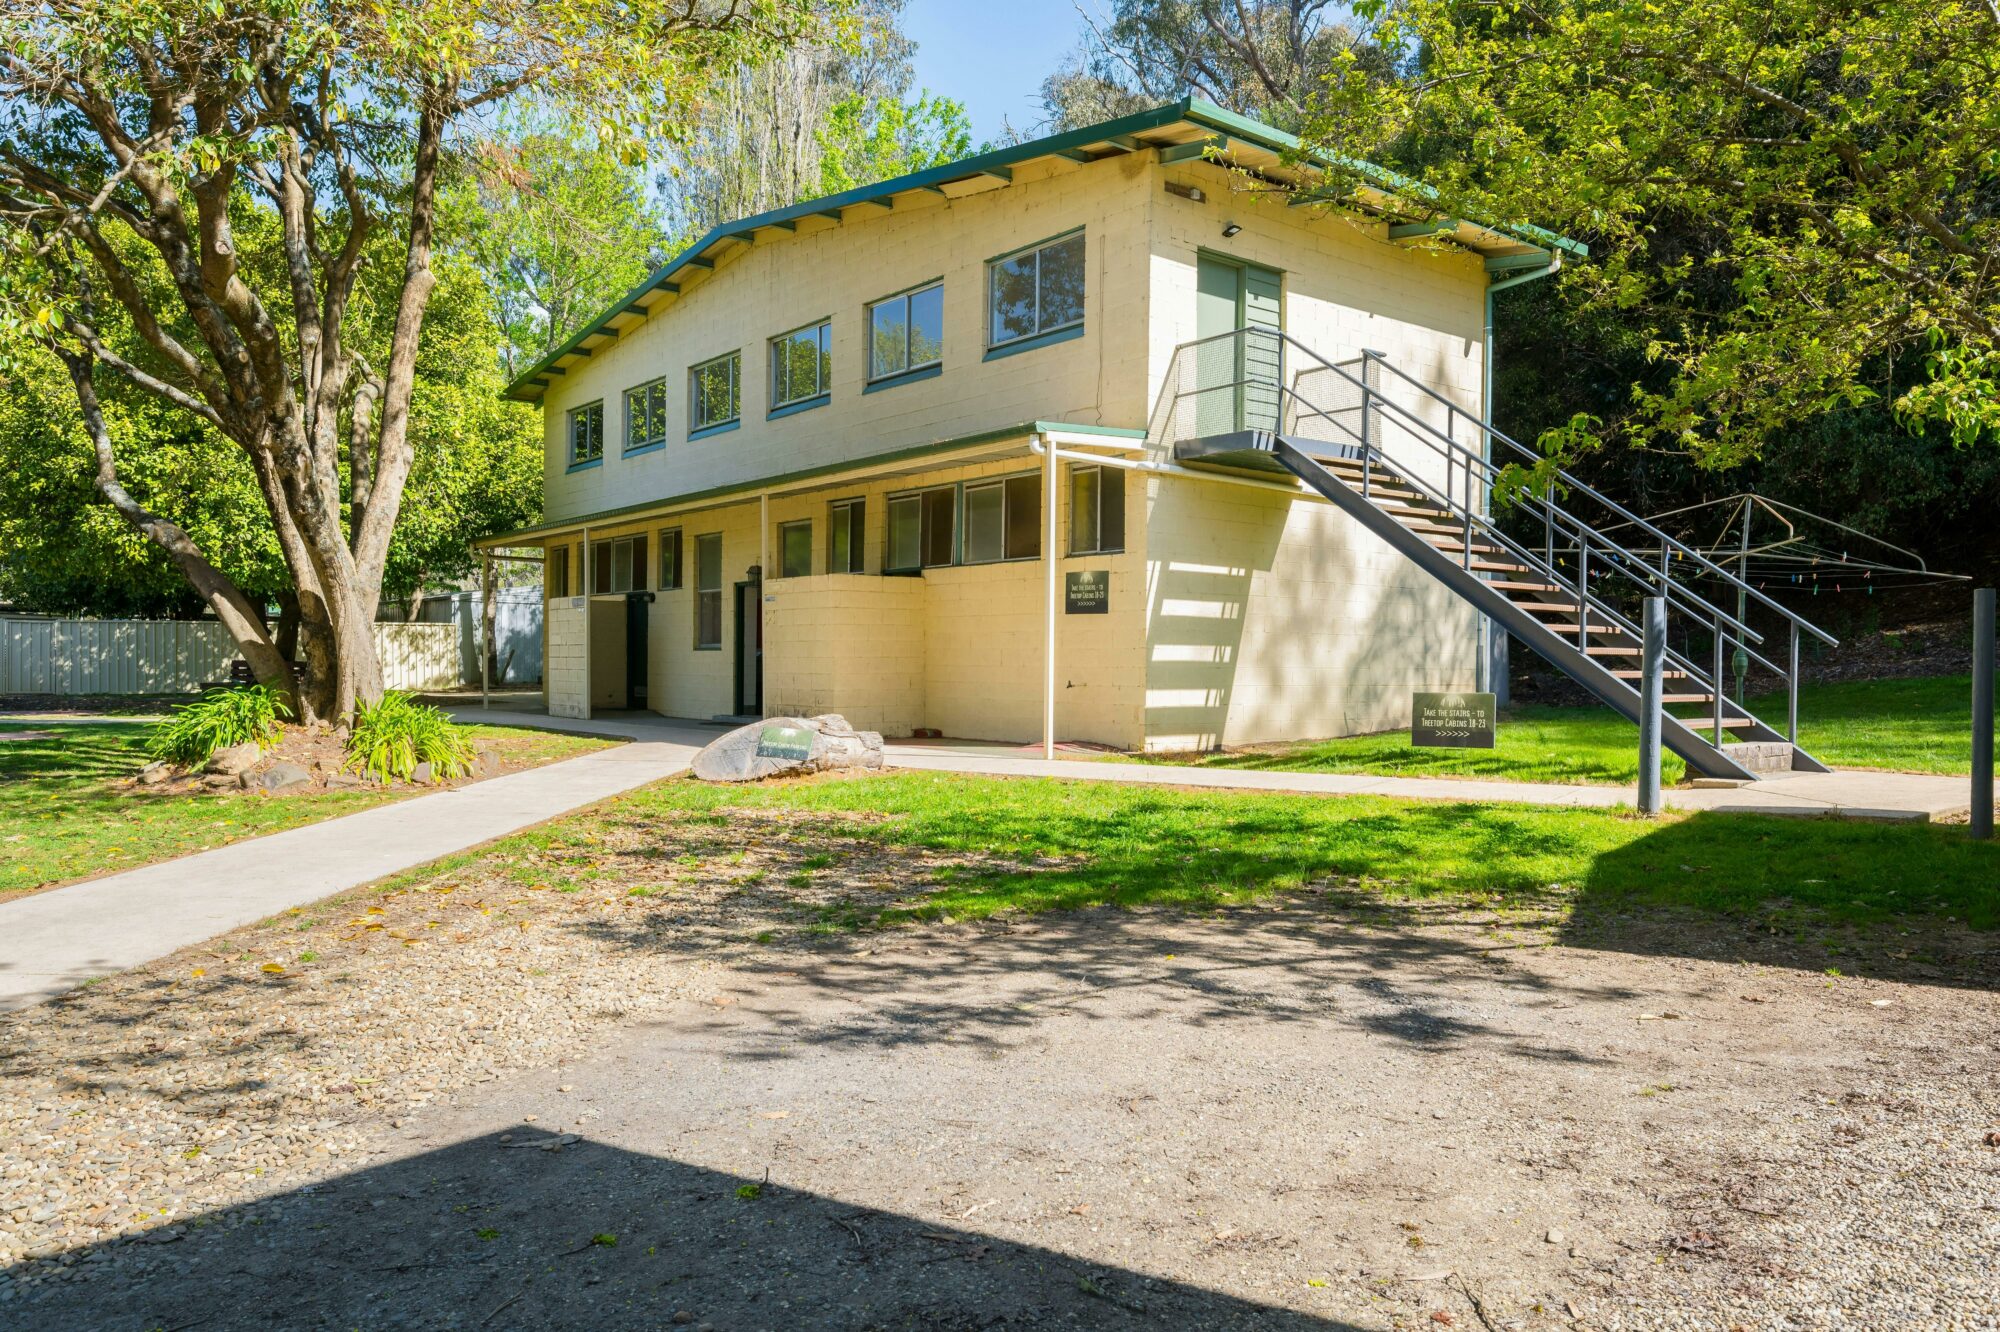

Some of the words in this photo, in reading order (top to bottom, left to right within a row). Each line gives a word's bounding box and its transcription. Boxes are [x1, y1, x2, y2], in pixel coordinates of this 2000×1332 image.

[1423, 707, 1436, 717] TAKE
[1438, 709, 1448, 717] THE
[1449, 709, 1471, 717] STAIRS
[1476, 710, 1485, 718] TO
[1421, 717, 1444, 727] TREETOP
[1445, 718, 1467, 728] CABINS
